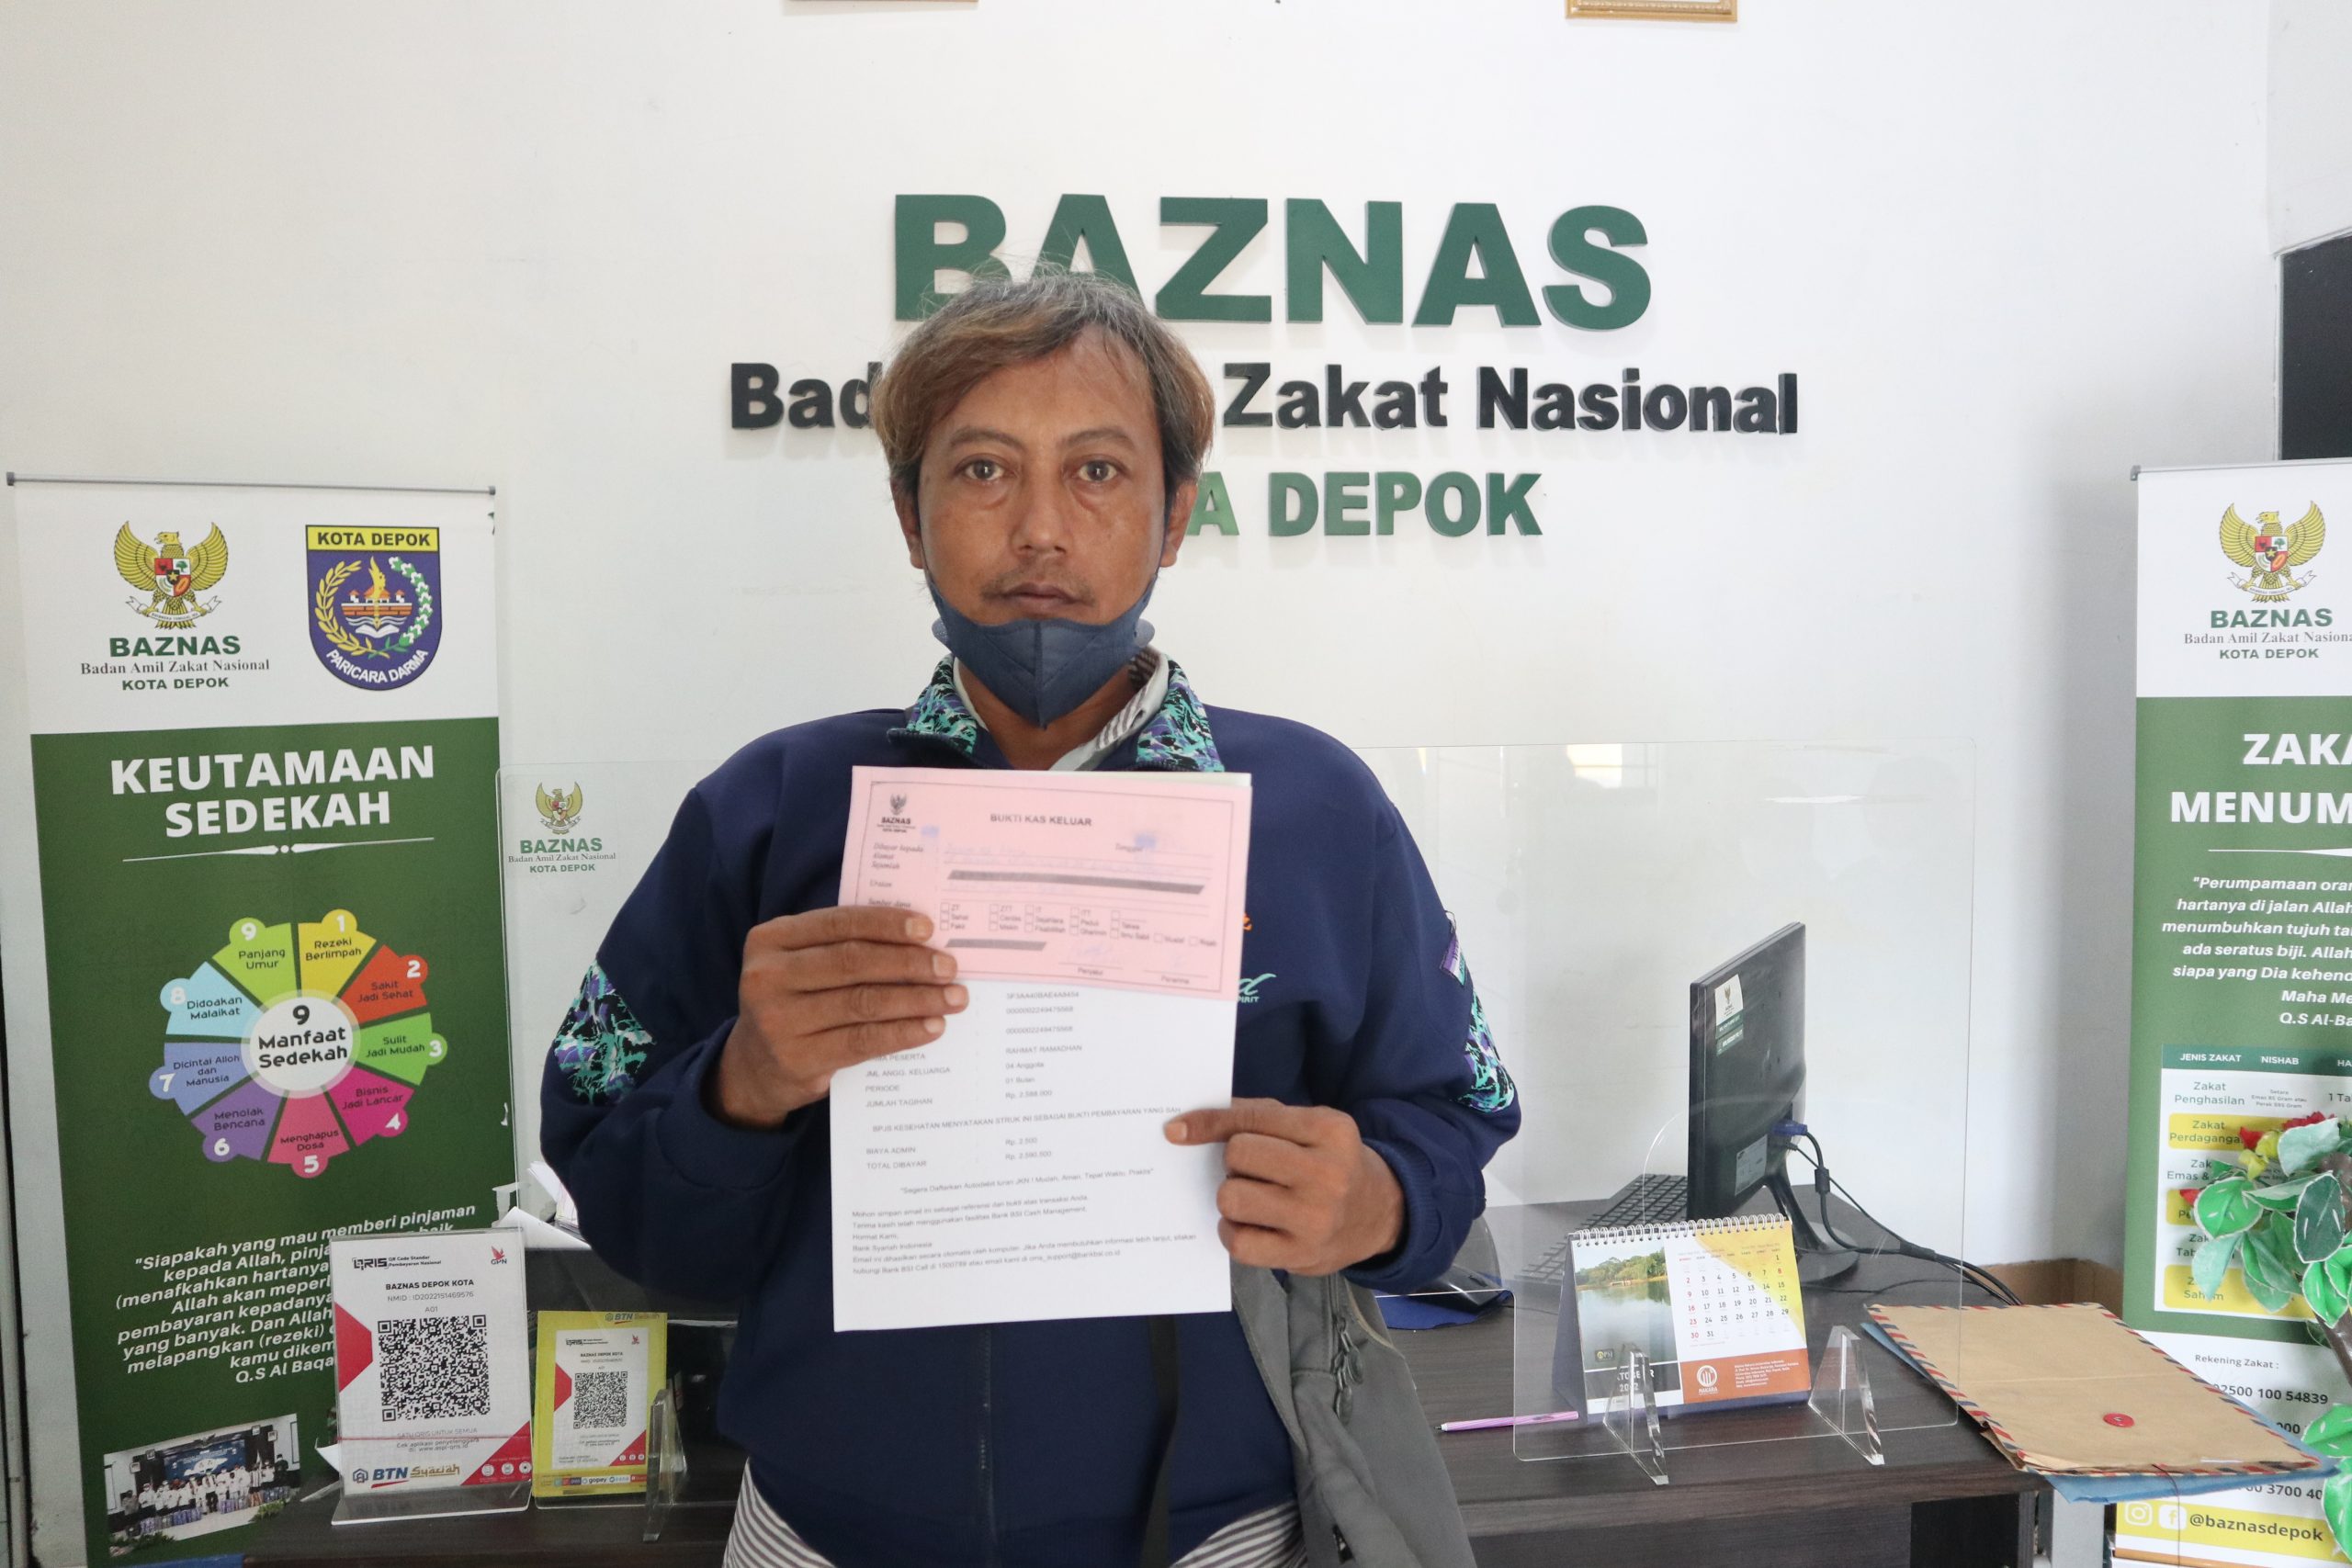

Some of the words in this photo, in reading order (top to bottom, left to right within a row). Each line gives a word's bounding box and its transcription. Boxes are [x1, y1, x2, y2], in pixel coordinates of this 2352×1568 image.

[894, 192, 1653, 331] BAZNAS
[731, 361, 884, 430] Bad
[1223, 362, 1448, 429] Zakat
[1477, 366, 1799, 434] Nasional
[1268, 472, 1543, 536] DEPOK
[317, 531, 366, 547] KOTA
[370, 532, 431, 547] DEPOK
[2211, 608, 2333, 628] BAZNAS
[2184, 632, 2224, 644] Badan
[2227, 632, 2257, 644] Amil
[2262, 632, 2299, 643] Zakat
[2303, 631, 2352, 643] Nasiona
[109, 635, 241, 658] BAZNAS
[2219, 649, 2259, 660] KOTA
[2265, 648, 2319, 659] DEPOK
[80, 660, 125, 674] Badan
[130, 660, 164, 673] Amil
[168, 660, 209, 673] Zakat
[212, 659, 270, 671] Nasional
[326, 649, 388, 682] PARICARA
[388, 649, 428, 682] DARMA
[121, 679, 166, 691] KOTA
[174, 677, 229, 689] DEPOK
[110, 745, 435, 795] KEUTAMAAN
[165, 791, 390, 838] SEDEKAH
[989, 814, 1022, 823] BUKTI
[1024, 815, 1046, 824] KAS
[1048, 815, 1091, 826] KELUAR
[520, 838, 602, 853] BAZNAS
[2193, 876, 2317, 891] "Perumpamaan
[2177, 898, 2246, 914] hartanya
[2250, 900, 2266, 911] di
[2267, 900, 2309, 914] jalan
[336, 915, 345, 933] 1
[2162, 922, 2283, 934] menumbuhkan
[2287, 924, 2330, 938] tujuh
[241, 923, 256, 941] 9
[314, 938, 352, 949] Rezeki
[238, 949, 286, 961] Panjang
[305, 948, 362, 963] Berlimpah
[2183, 943, 2211, 955] ada
[2214, 944, 2274, 956] seratus
[2277, 945, 2307, 960] biji.
[246, 960, 279, 970] Umur
[406, 960, 421, 978] 2
[2173, 965, 2215, 979] siapa
[2217, 967, 2257, 980] yang
[2261, 966, 2288, 979] Dia
[371, 980, 399, 990] Sakit
[170, 987, 186, 1004] 8
[382, 989, 413, 999] Sehat
[2281, 990, 2327, 1003] Maha
[187, 996, 243, 1010] Didoakan
[190, 1007, 241, 1021] Malaikat
[292, 1005, 310, 1025] 9
[2279, 1012, 2308, 1025] Q.S
[258, 1027, 346, 1050] Manfaat
[383, 1035, 407, 1045] Sulit
[389, 1043, 425, 1055] Mudah
[428, 1041, 442, 1057] 3
[174, 1058, 212, 1070] Dicintai
[259, 1045, 348, 1069] Sedekah
[2180, 1053, 2207, 1062] JENIS
[2261, 1056, 2299, 1065] NISHAB
[198, 1067, 217, 1076] dan
[158, 1073, 175, 1092] 7
[186, 1076, 229, 1087] Manusia
[2194, 1082, 2226, 1091] Zakat
[356, 1085, 389, 1097] Bisnis
[367, 1093, 403, 1106] Lancar
[2175, 1095, 2245, 1106] Penghasilan
[214, 1108, 264, 1121] Menolak
[386, 1112, 401, 1130] 4
[214, 1118, 266, 1131] Bencana
[894, 1122, 940, 1132] KESEHATAN
[942, 1119, 993, 1128] MENYATAKAN
[2192, 1121, 2225, 1129] Zakat
[280, 1129, 339, 1145] Menghapus
[214, 1138, 230, 1156] 6
[297, 1141, 324, 1152] Dosa
[304, 1155, 319, 1173] 5
[2167, 1171, 2198, 1180] Emas
[231, 1238, 276, 1257] yang
[280, 1231, 317, 1246] mau
[399, 1205, 476, 1229] pinjaman
[164, 1259, 232, 1283] kepada
[352, 1258, 389, 1270] QRIS
[116, 1276, 248, 1309] (menafkahkan
[253, 1261, 329, 1283] hartanya
[386, 1282, 419, 1291] BAZNAS
[171, 1293, 219, 1314] Allah
[222, 1286, 266, 1303] akan
[118, 1309, 234, 1345] pembayaran
[123, 1338, 170, 1361] yang
[175, 1323, 246, 1347] banyak.
[251, 1318, 285, 1333] Dan
[288, 1309, 333, 1326] Allah
[127, 1339, 254, 1374] melapangkan
[259, 1324, 324, 1348] (rezeki)
[230, 1349, 279, 1369] kamu
[2195, 1355, 2242, 1367] Rekening
[2245, 1359, 2274, 1369] Zakat
[235, 1365, 266, 1383] Q.S
[269, 1361, 288, 1376] Al
[2258, 1389, 2281, 1400] 100
[2286, 1392, 2328, 1404] 54839
[372, 1468, 409, 1480] BTN
[2267, 1484, 2301, 1497] 3700
[2189, 1514, 2324, 1541] @baznasdepok
